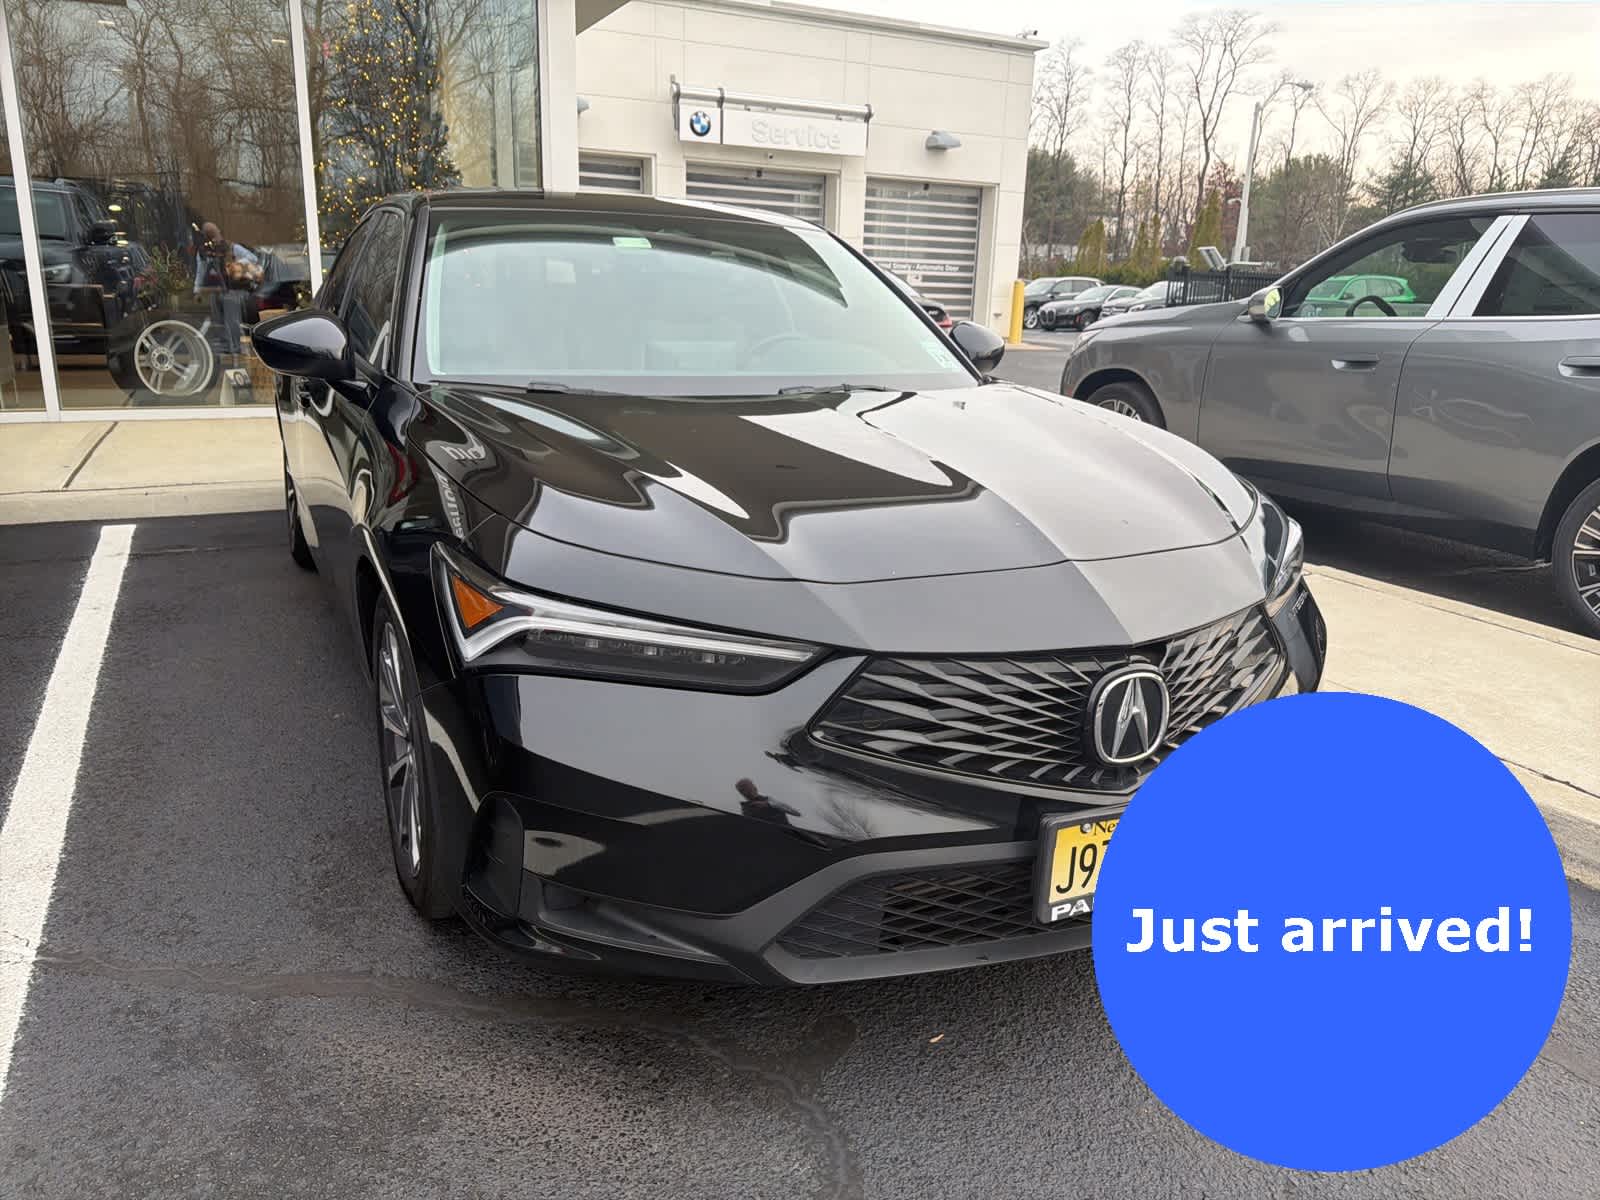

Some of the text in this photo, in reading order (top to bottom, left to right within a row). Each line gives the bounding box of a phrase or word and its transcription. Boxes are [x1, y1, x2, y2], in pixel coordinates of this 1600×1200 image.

[751, 118, 841, 149] Service
[1093, 820, 1118, 836] Ne
[1050, 899, 1094, 922] PA
